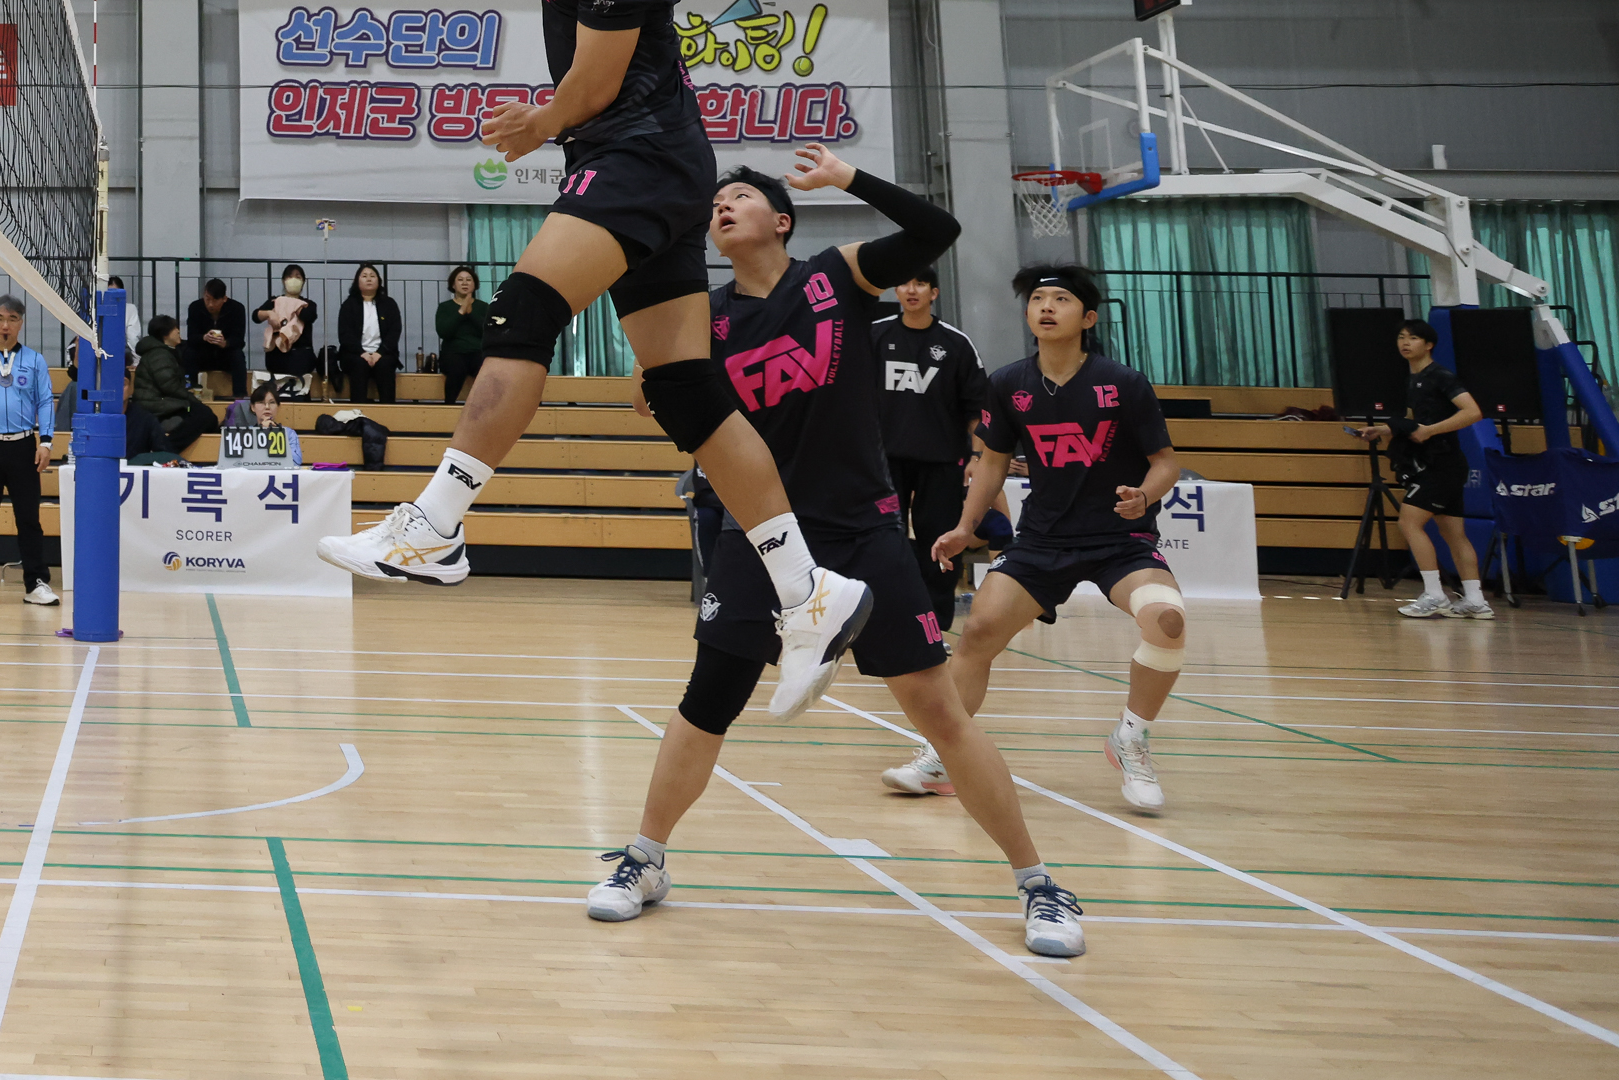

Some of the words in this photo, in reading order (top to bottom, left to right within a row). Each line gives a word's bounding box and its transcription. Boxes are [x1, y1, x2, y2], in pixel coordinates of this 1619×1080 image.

[276, 6, 501, 70] 선수단의
[267, 79, 421, 141] 인제군
[695, 81, 858, 143] 합니다.
[803, 272, 834, 305] 10
[725, 319, 833, 412] FAV
[885, 360, 940, 394] FAV
[1093, 385, 1120, 408] 12
[225, 432, 242, 456] 14
[243, 432, 253, 448] 0
[257, 432, 267, 448] 0
[268, 431, 285, 455] 20
[1025, 420, 1112, 467] FAV
[176, 529, 233, 542] SCORER
[757, 531, 788, 556] FAV
[1156, 539, 1189, 550] GATE
[185, 556, 246, 569] KORYVA
[916, 610, 942, 644] 10
